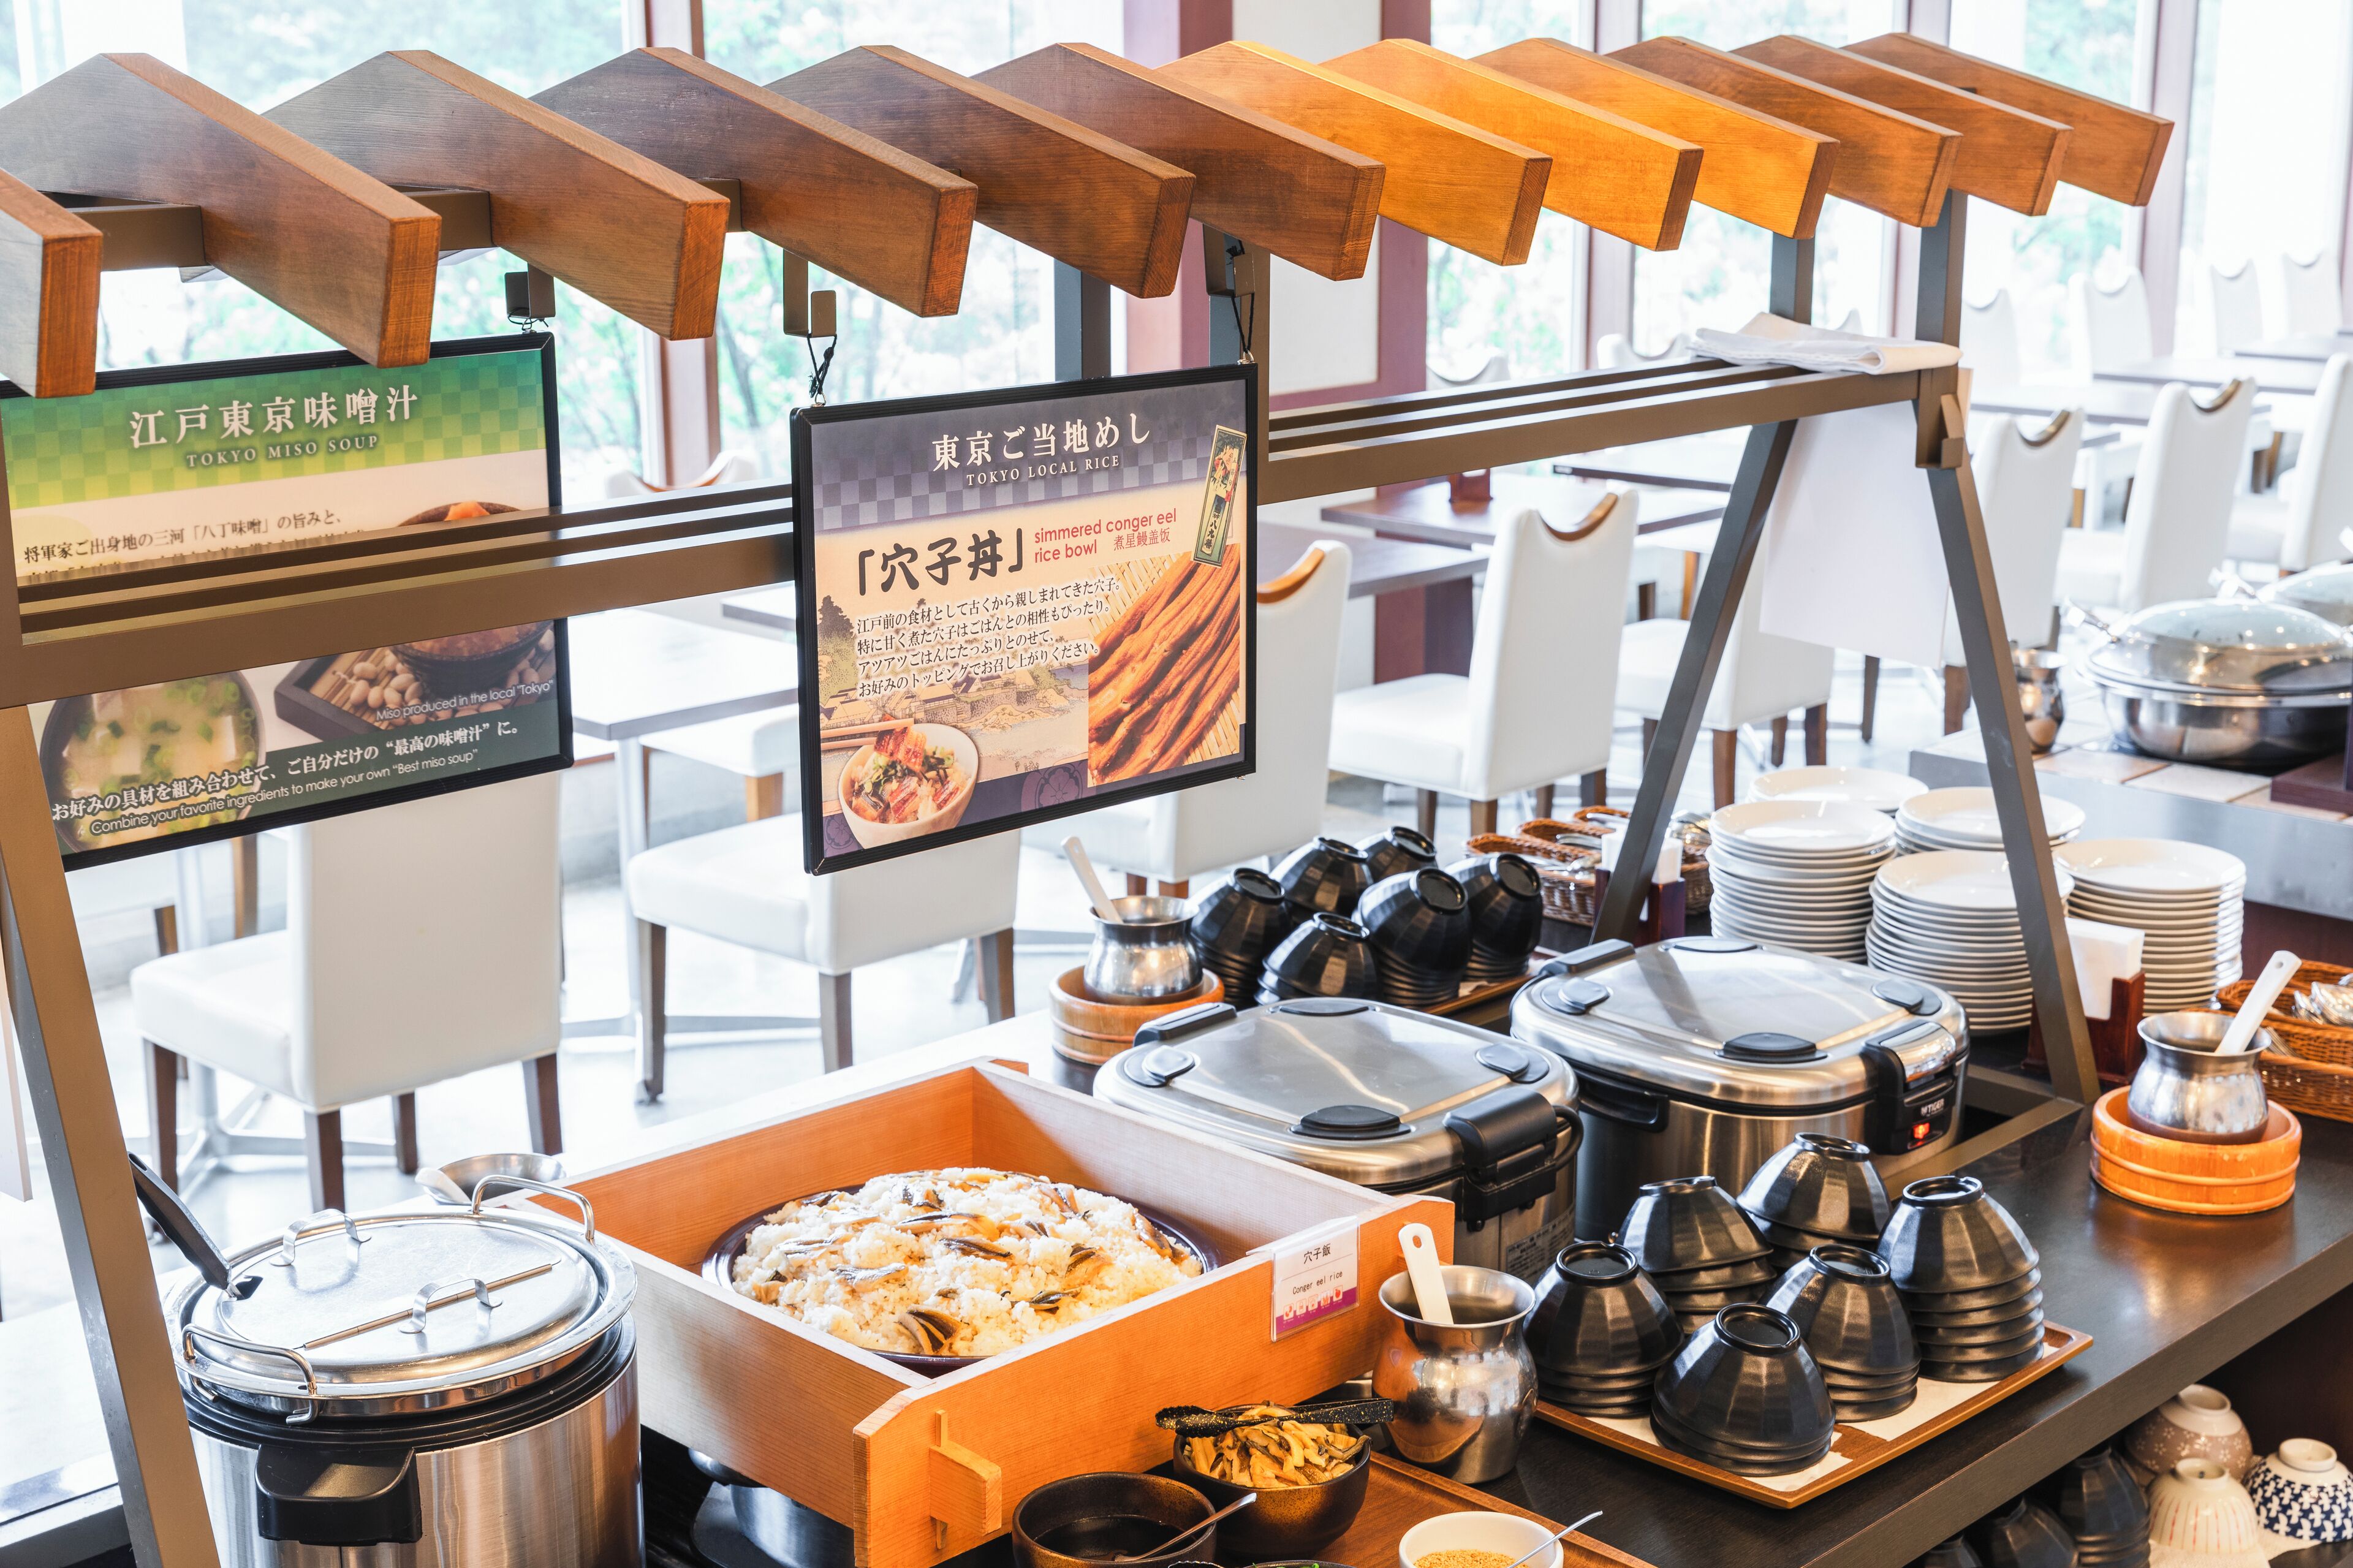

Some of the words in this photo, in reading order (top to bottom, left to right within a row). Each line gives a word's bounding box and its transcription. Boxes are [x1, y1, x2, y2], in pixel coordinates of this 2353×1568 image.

[130, 384, 418, 449] 江戸東京味噌汁
[187, 448, 257, 467] TOKYO
[268, 441, 317, 459] MISO
[328, 435, 378, 453] SOUP
[931, 413, 1150, 472] 東京ご当地めし
[966, 467, 1020, 486] TOKYO
[1028, 460, 1077, 478] LOCAL
[1085, 455, 1120, 471] RICE
[1034, 519, 1102, 543] simmered
[1105, 515, 1153, 532] conger
[1156, 508, 1176, 525] eel
[858, 528, 1023, 596] 「穴子丼」
[1034, 547, 1061, 563] rice
[1065, 539, 1097, 558] bowl
[858, 577, 1120, 634] 江戸前の食材として古くから親しまれてきた穴子。
[858, 600, 1109, 655] 特に甘く煮た穴子はごはんとの相性もぴったり。
[858, 629, 1053, 675] アツアツごはんにたっぷりとのせて、
[859, 643, 1098, 697] お好みのトッピングでお召し上がりください。
[376, 708, 401, 721] Miso
[403, 697, 457, 718] produced
[459, 695, 469, 706] in
[470, 692, 487, 703] the
[490, 687, 516, 701] local
[91, 814, 148, 834] Combine
[149, 809, 178, 826] your
[180, 799, 224, 816] favorite
[227, 786, 289, 809] ingredients
[292, 782, 303, 795] to
[306, 776, 338, 792] make
[341, 773, 364, 788] your
[366, 768, 391, 781] own
[422, 756, 446, 770] miso
[1303, 1243, 1331, 1265] 穴子飯
[1292, 1281, 1313, 1295] Conger
[1316, 1275, 1326, 1286] eel
[1329, 1270, 1343, 1282] rice
